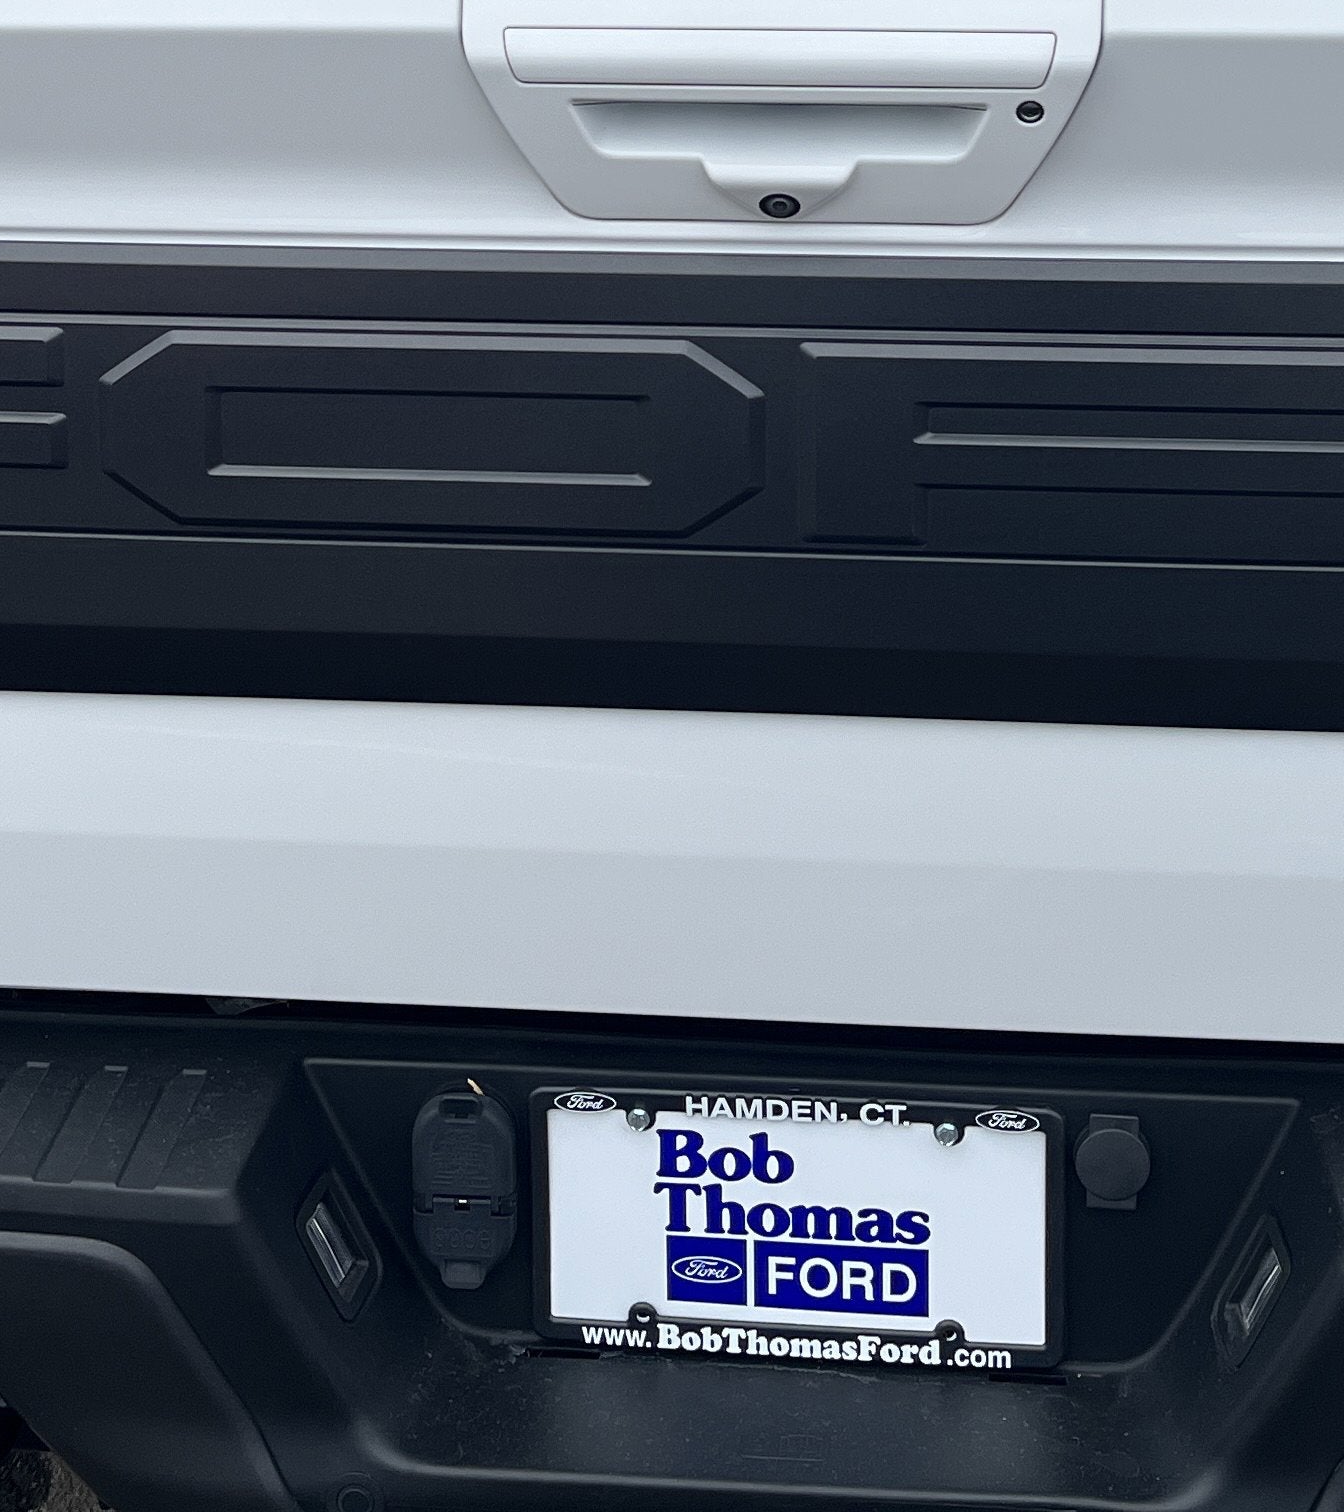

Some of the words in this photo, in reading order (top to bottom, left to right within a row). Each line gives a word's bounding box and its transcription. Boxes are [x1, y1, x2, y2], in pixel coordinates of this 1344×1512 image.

[685, 1096, 848, 1124] HAMDEN,
[859, 1103, 910, 1126] CT.
[656, 1128, 795, 1184] Bob
[653, 1182, 932, 1245] Thomas
[767, 1256, 918, 1303] FORD
[582, 1322, 1012, 1370] www.BobThomasFord.com
